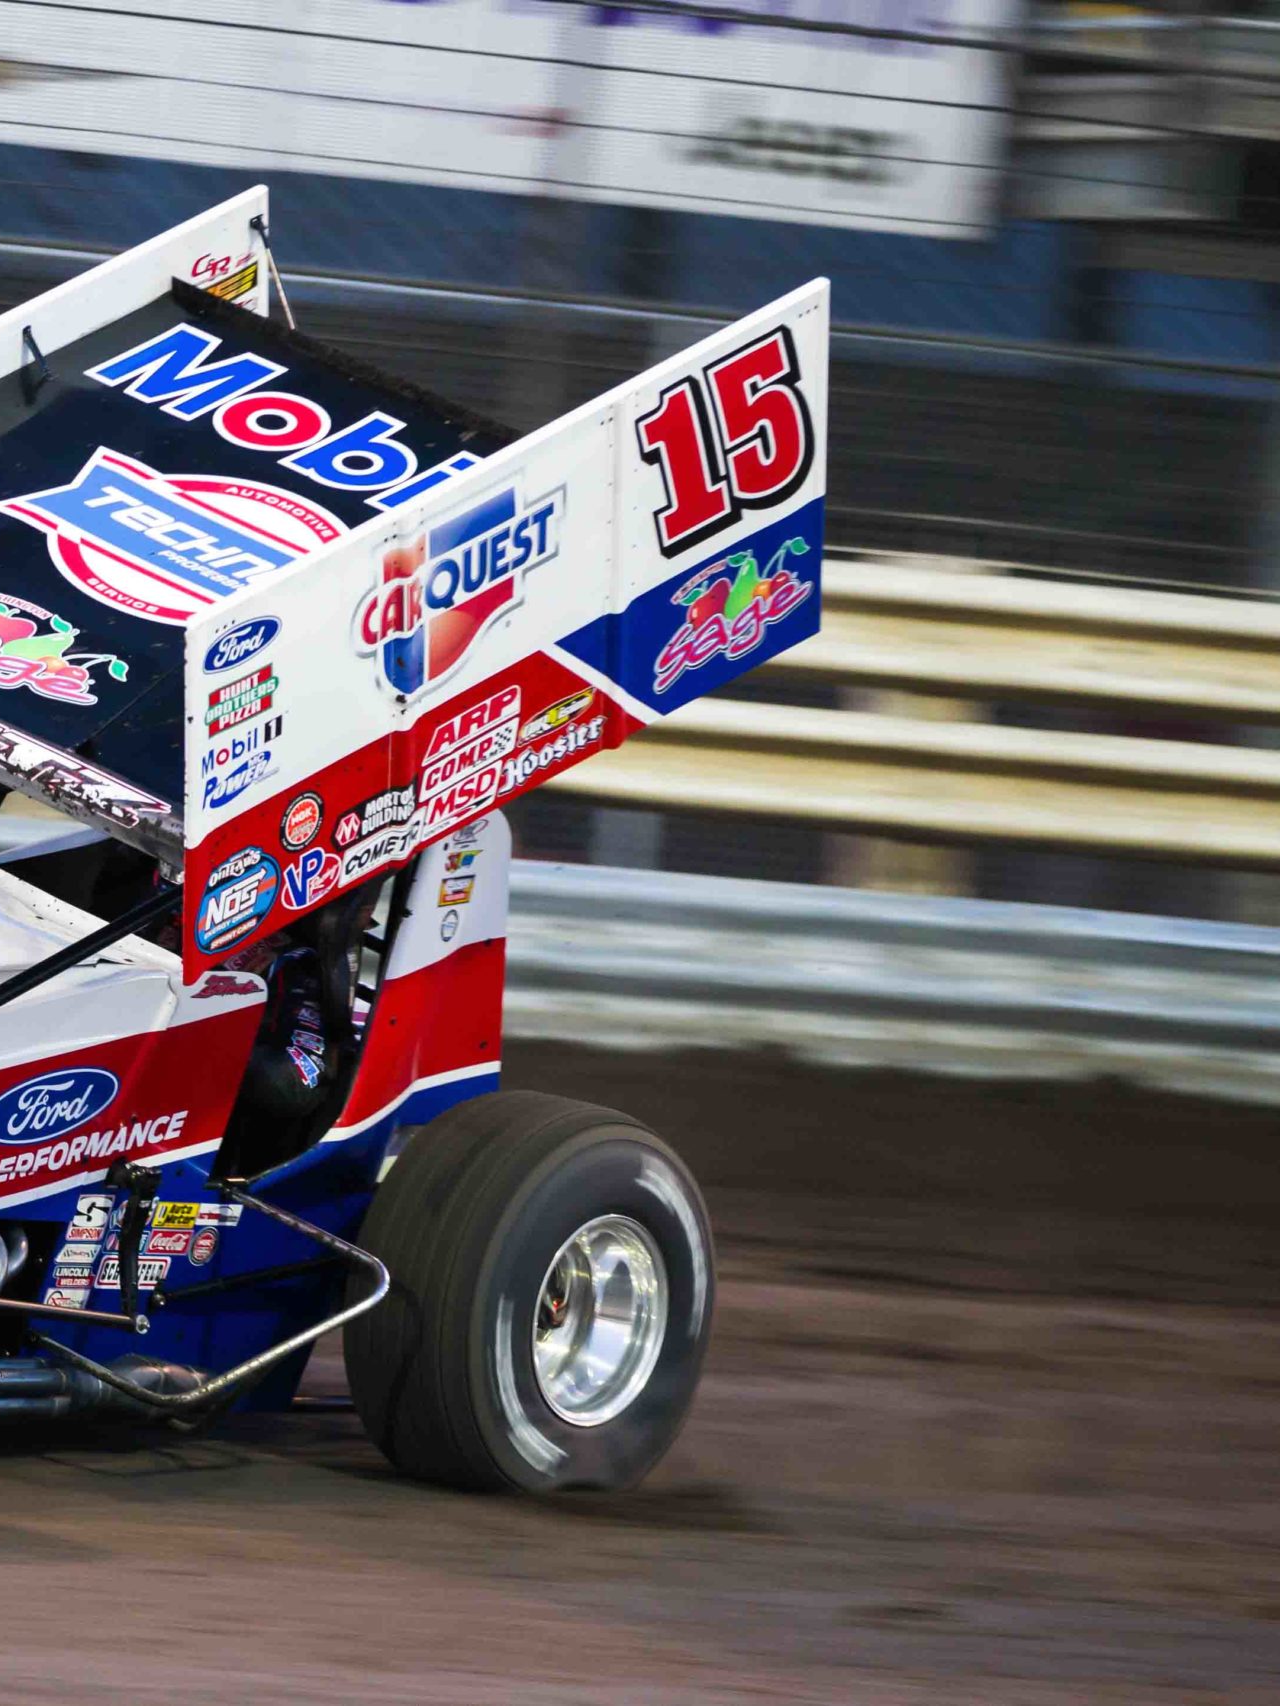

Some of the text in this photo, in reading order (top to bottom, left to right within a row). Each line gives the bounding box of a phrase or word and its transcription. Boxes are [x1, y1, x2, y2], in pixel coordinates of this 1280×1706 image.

[83, 322, 488, 512] Mobi
[635, 325, 815, 558] 15
[224, 485, 337, 539] AUTOMOTIVE
[85, 576, 160, 614] SERVICE
[360, 502, 556, 646] CARQUEST
[213, 625, 266, 668] Ford
[219, 671, 261, 703] HUNT
[218, 701, 262, 731] PIZZA
[426, 686, 517, 758] ARP
[201, 714, 283, 780] Mobil 1
[425, 735, 494, 791] COMP
[498, 717, 606, 797] Hoosier
[428, 766, 497, 826] MSD
[205, 867, 267, 931] NOS
[284, 848, 325, 910] VP
[6, 1079, 95, 1137] Ford
[69, 1228, 104, 1240] SIMPSON
[170, 1204, 194, 1215] Auto
[149, 1232, 190, 1251] Coca-Cola
[56, 1267, 91, 1278] LINCOLN
